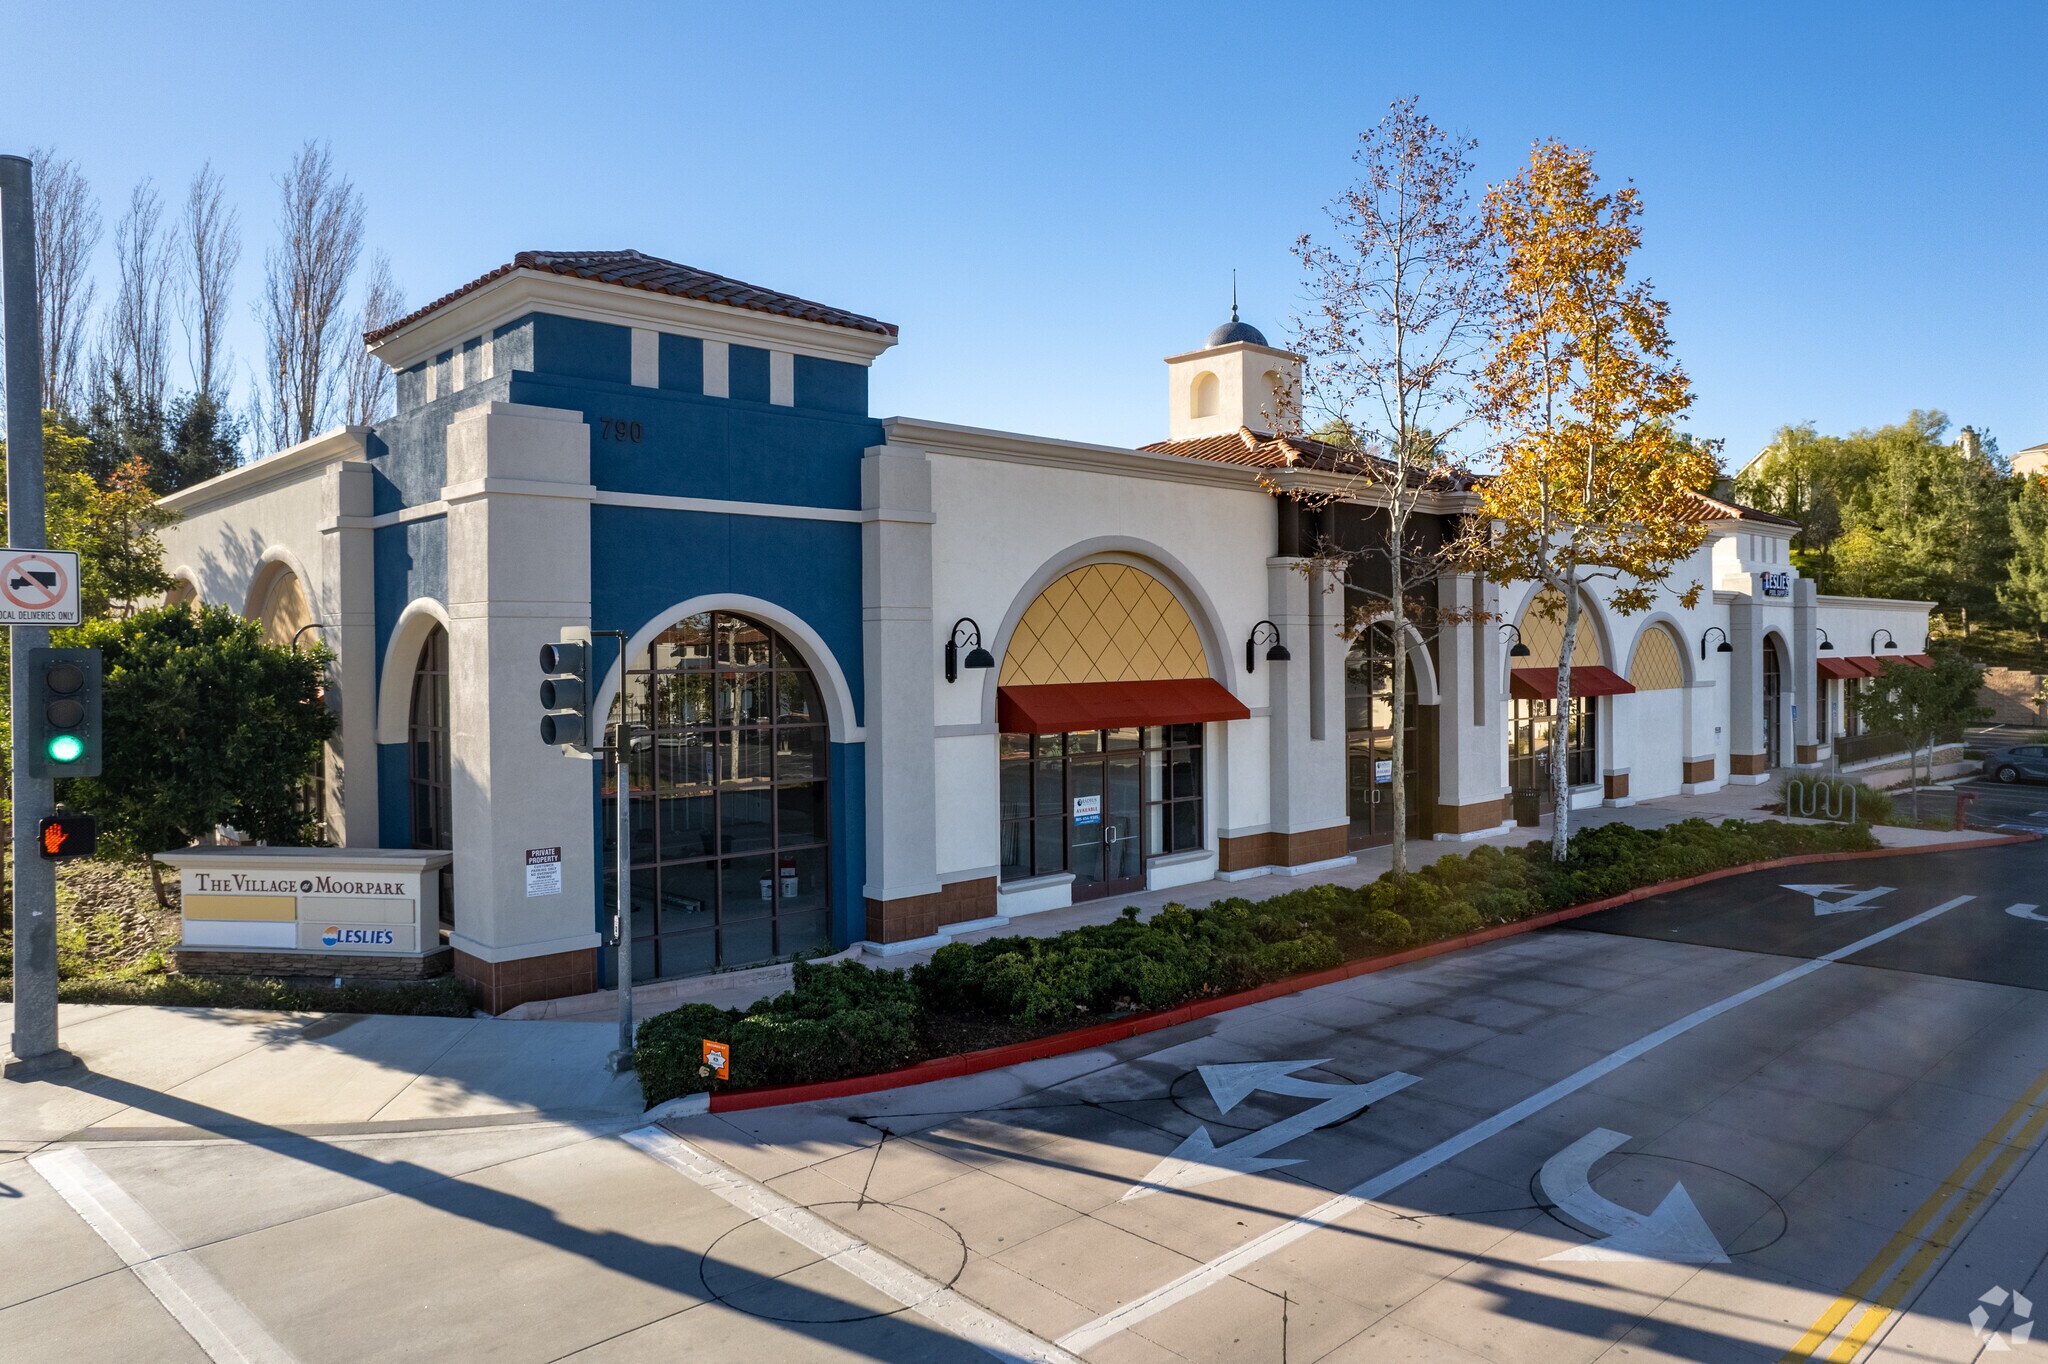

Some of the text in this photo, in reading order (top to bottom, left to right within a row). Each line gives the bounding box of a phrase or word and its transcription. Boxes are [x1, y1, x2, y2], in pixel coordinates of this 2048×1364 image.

[600, 416, 642, 444] 790
[19, 611, 56, 620] DELIVERIES
[58, 611, 74, 620] ONLY
[528, 854, 560, 865] PROPERTY
[531, 848, 556, 858] PRIVATE
[231, 874, 298, 893] VILLAGE
[315, 876, 406, 896] MOORPARK
[336, 928, 394, 945] LESLIE'S
